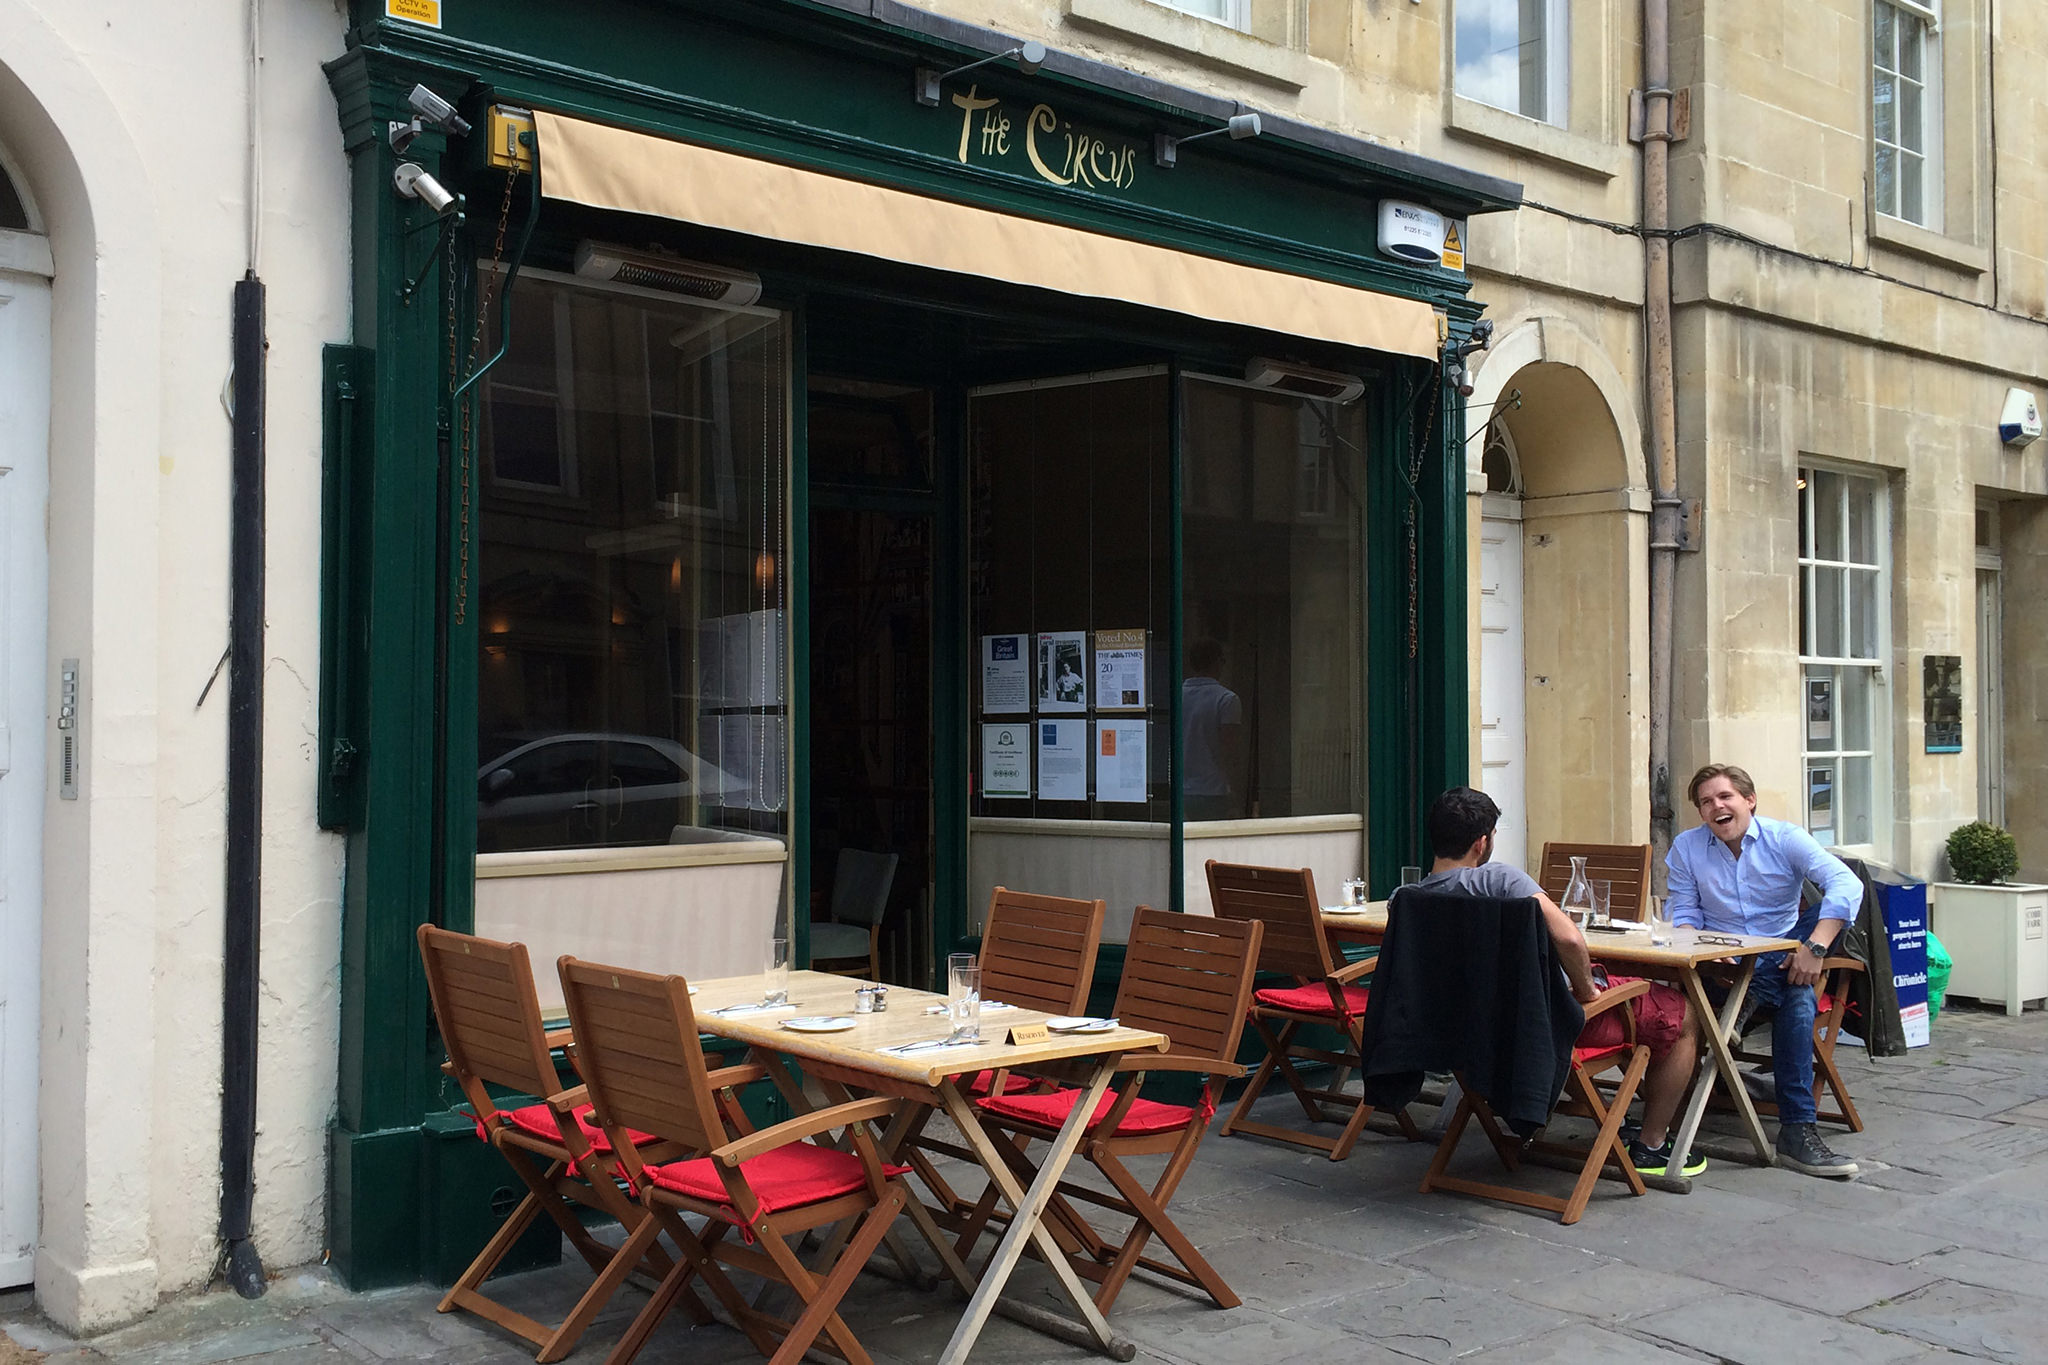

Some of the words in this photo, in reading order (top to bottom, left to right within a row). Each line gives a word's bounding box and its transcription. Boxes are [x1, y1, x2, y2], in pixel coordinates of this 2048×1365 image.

[396, 5, 431, 18] Operation
[1096, 632, 1121, 642] Voted
[1101, 663, 1113, 673] 20
[1892, 931, 1911, 941] property
[1893, 971, 1927, 987] Chronicle
